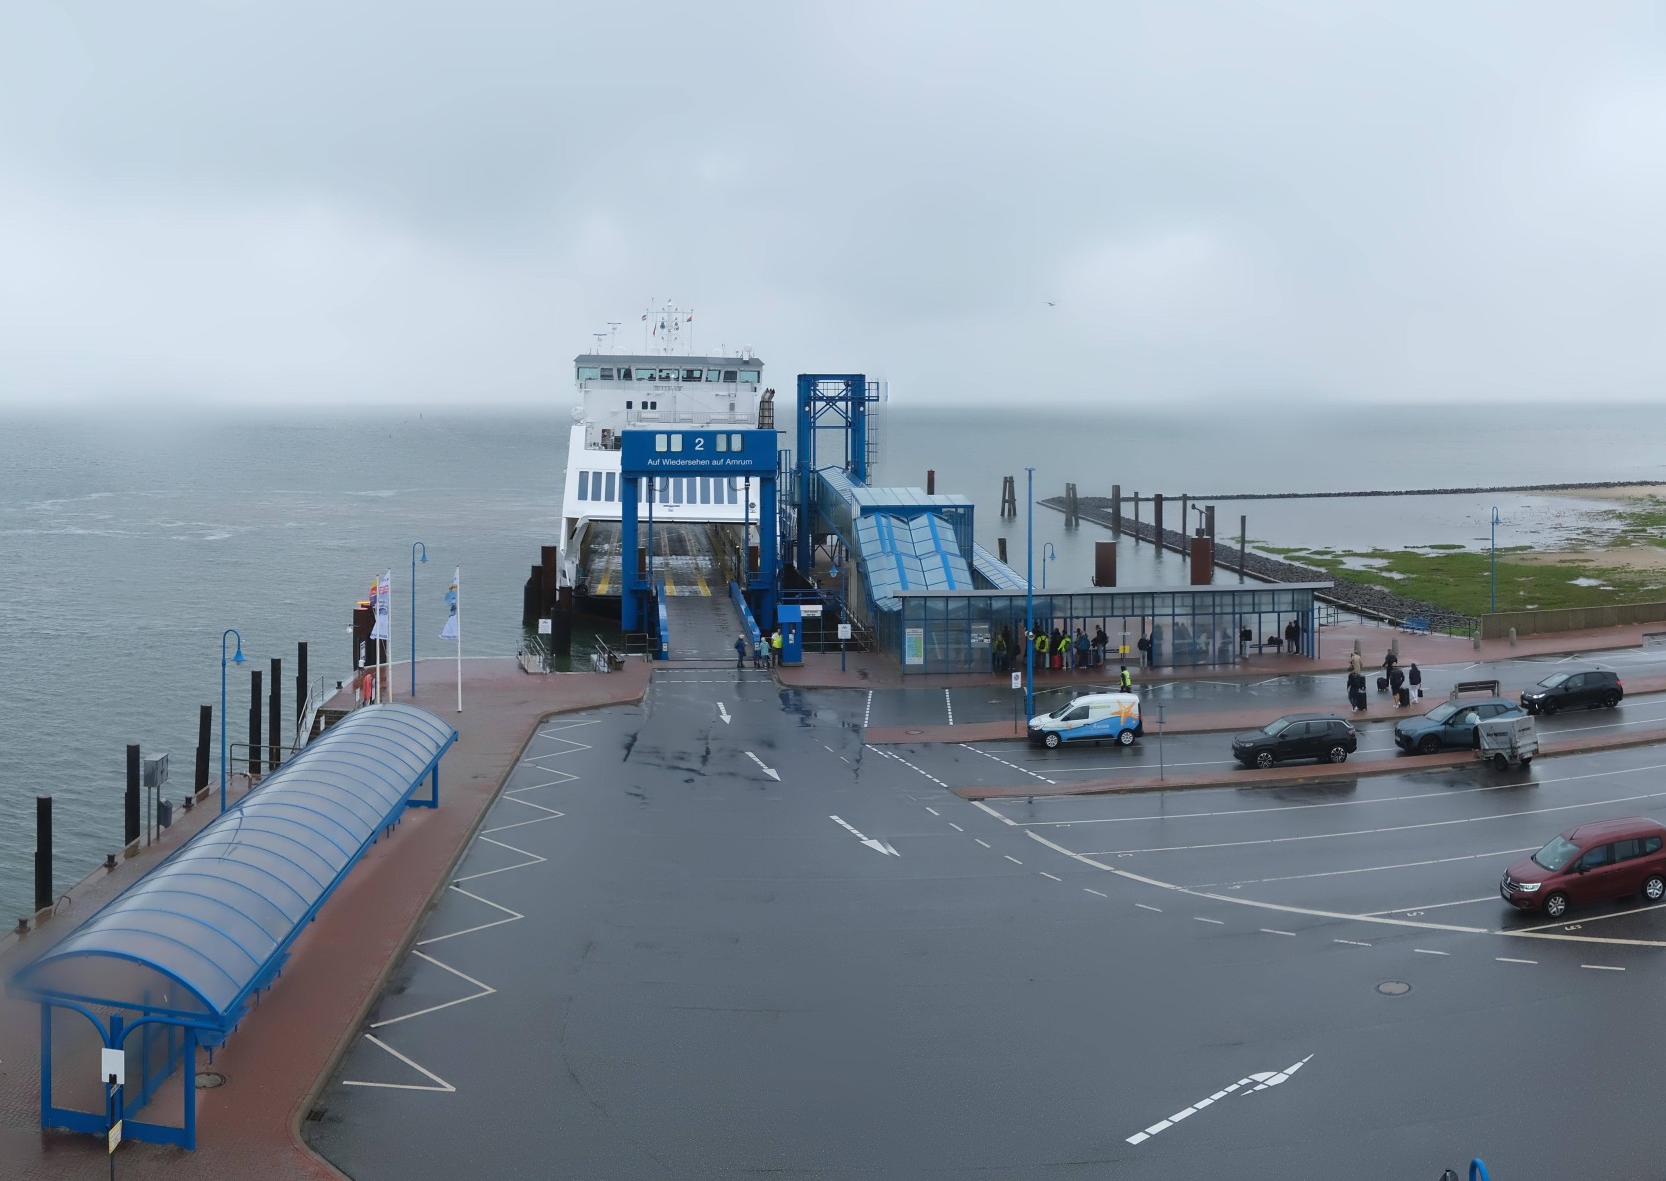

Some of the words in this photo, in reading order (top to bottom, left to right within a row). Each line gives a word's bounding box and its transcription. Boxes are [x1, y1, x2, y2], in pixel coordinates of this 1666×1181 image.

[695, 437, 704, 450] 2
[647, 458, 660, 466] Auf
[661, 458, 710, 466] Wiedersehen
[711, 458, 724, 466] auf
